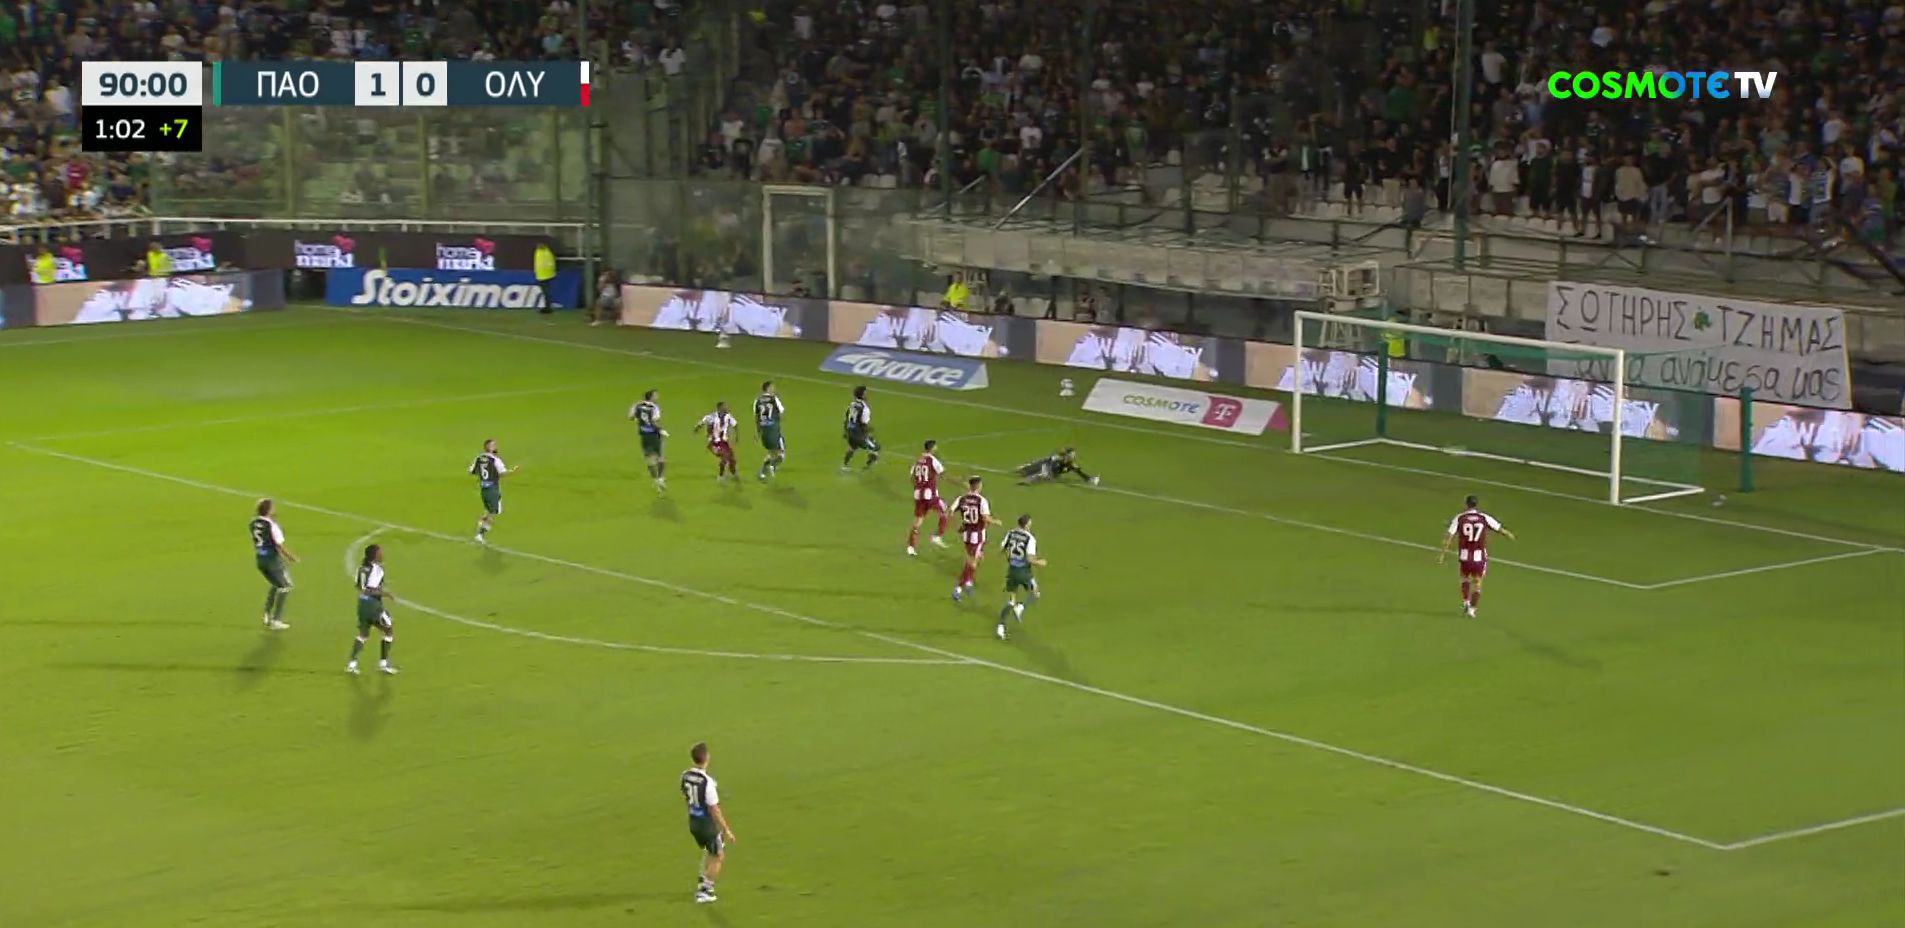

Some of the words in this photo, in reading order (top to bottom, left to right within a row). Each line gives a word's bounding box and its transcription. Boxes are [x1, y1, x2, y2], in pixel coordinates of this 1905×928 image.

[436, 243, 481, 257] home
[351, 269, 546, 309] Stoiximan
[963, 505, 979, 525] 20
[1463, 523, 1484, 542] 97
